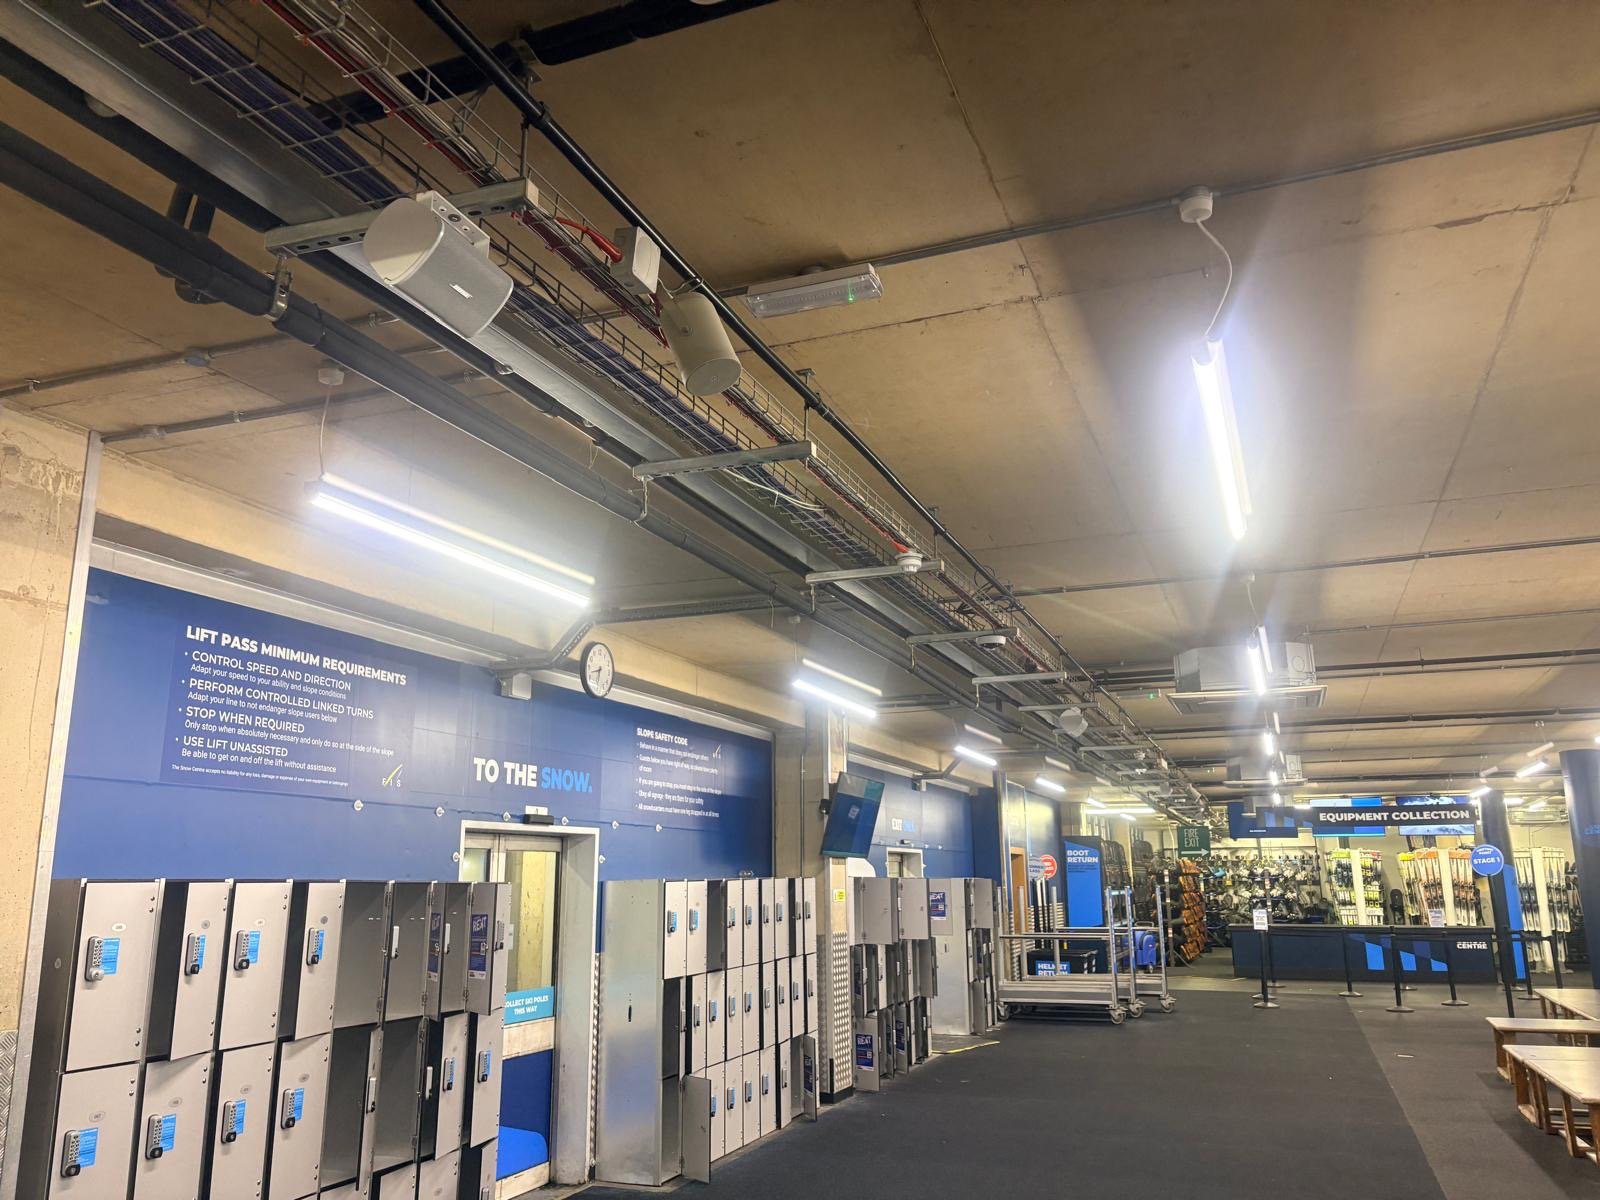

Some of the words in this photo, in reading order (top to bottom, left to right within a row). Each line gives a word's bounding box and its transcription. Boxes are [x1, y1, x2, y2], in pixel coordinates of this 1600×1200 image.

[186, 625, 218, 644] LIFT
[221, 633, 258, 653] PASS
[261, 642, 320, 667] MINIMUM
[322, 656, 407, 686] REQUIREMENTS
[190, 663, 212, 675] Adapt
[212, 669, 227, 677] your
[229, 671, 248, 682] speed
[257, 677, 271, 686] your
[271, 679, 289, 690] ability
[290, 683, 301, 691] and
[303, 685, 318, 695] slope
[319, 688, 346, 700] conditions
[192, 650, 244, 670] CONTROL
[246, 661, 279, 676] SPEED
[281, 669, 302, 680] AND
[304, 674, 351, 691] DIRECTION
[187, 691, 209, 703] Adapt
[209, 695, 224, 704] your
[226, 697, 238, 706] line
[240, 700, 246, 708] to
[247, 701, 258, 710] not
[258, 703, 287, 715] endanger
[288, 708, 304, 718] slope
[305, 710, 320, 720] users
[321, 713, 337, 723] below
[189, 678, 243, 696] PERFORM
[245, 688, 310, 708] CONTROLLED
[313, 700, 345, 714] LINKED
[346, 706, 374, 719] TURNS
[186, 706, 216, 719] STOP
[219, 711, 252, 726] WHEN
[254, 716, 305, 733] REQUIRED
[183, 735, 204, 747] USE
[206, 738, 228, 750] LIFT
[230, 741, 288, 757] UNASSISTED
[184, 719, 200, 731] Only
[201, 722, 217, 732] stop
[218, 725, 236, 734] when
[237, 728, 269, 740] absolutely
[269, 733, 300, 744] necessary
[300, 736, 311, 745] and
[311, 739, 324, 748] only
[346, 742, 354, 751] the
[354, 744, 365, 752] side
[366, 745, 372, 753] of
[372, 746, 380, 754] the
[380, 747, 394, 758] slope
[636, 727, 654, 739] SLOPE
[655, 731, 674, 743] SAFETY
[674, 735, 688, 746] CODE
[181, 748, 192, 757] Be
[193, 749, 208, 759] able
[209, 751, 216, 760] to
[218, 752, 229, 762] get
[230, 754, 239, 762] on
[240, 755, 252, 764] and
[253, 756, 263, 765] off
[263, 757, 273, 766] the
[275, 758, 283, 767] lift
[284, 760, 306, 770] without
[307, 763, 336, 774] assistance
[473, 757, 499, 783] TO
[503, 761, 538, 787] THE
[541, 767, 592, 793] SNOW.
[1319, 812, 1389, 822] EQUIPMENT
[1392, 810, 1470, 820] COLLECTION
[1184, 828, 1198, 838] FIRE
[1184, 838, 1199, 848] EXIT
[514, 1007, 525, 1015] THIS
[526, 1005, 538, 1013] WAY
[534, 995, 549, 1003] POLES
